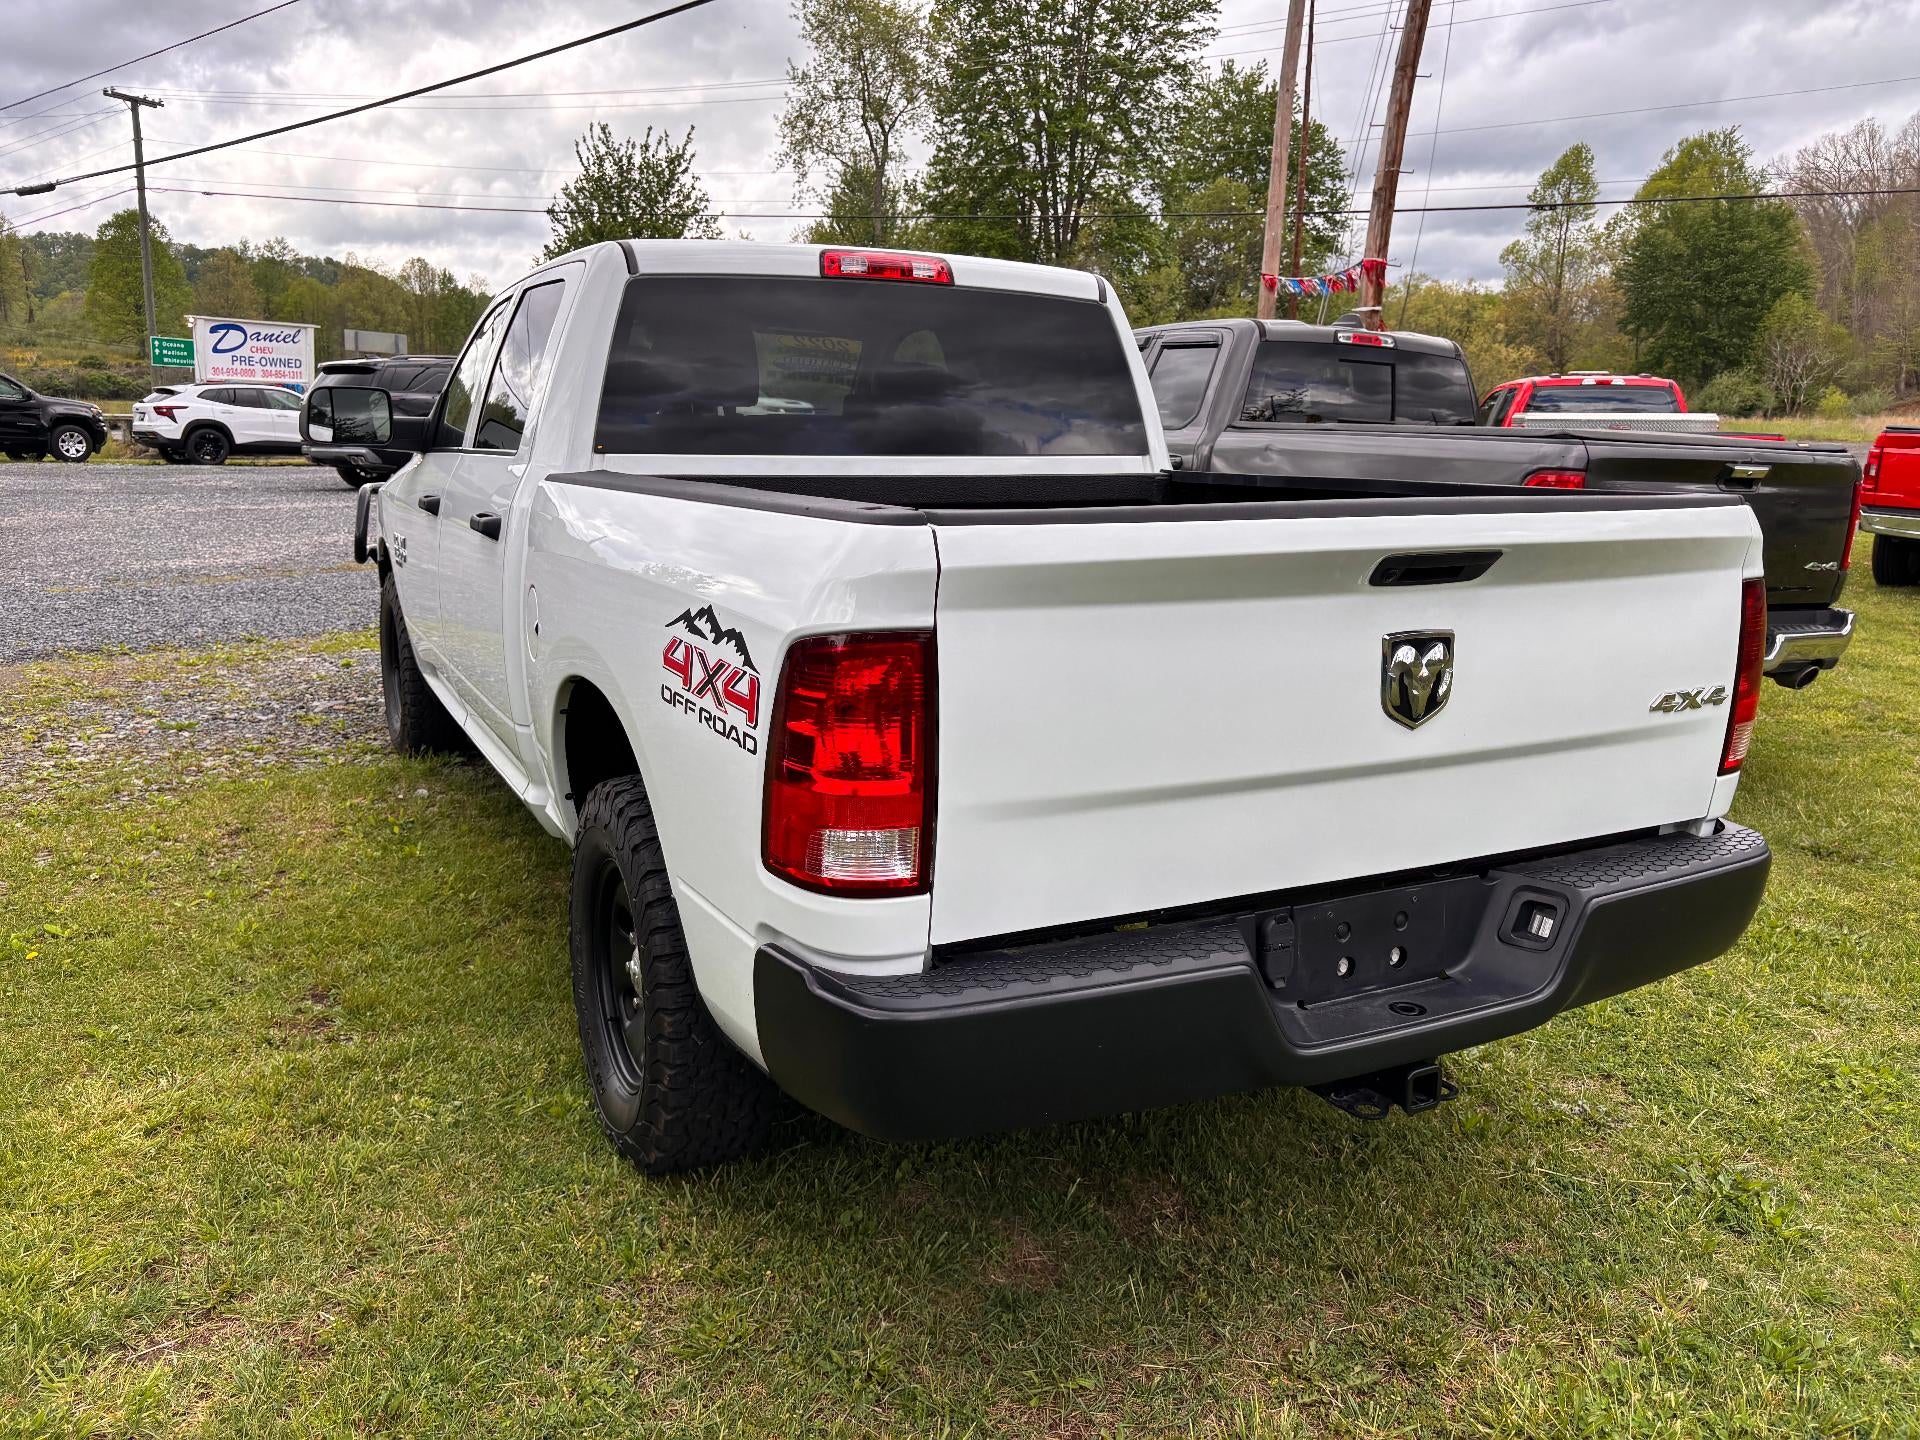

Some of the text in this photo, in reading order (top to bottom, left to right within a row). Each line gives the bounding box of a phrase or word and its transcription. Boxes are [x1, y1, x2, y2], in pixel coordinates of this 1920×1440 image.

[209, 323, 301, 353] Daniel
[250, 345, 274, 355] CHEV
[231, 355, 302, 369] PRE-OWNED
[663, 635, 761, 731] 4X4
[661, 683, 758, 756] OFF ROAD
